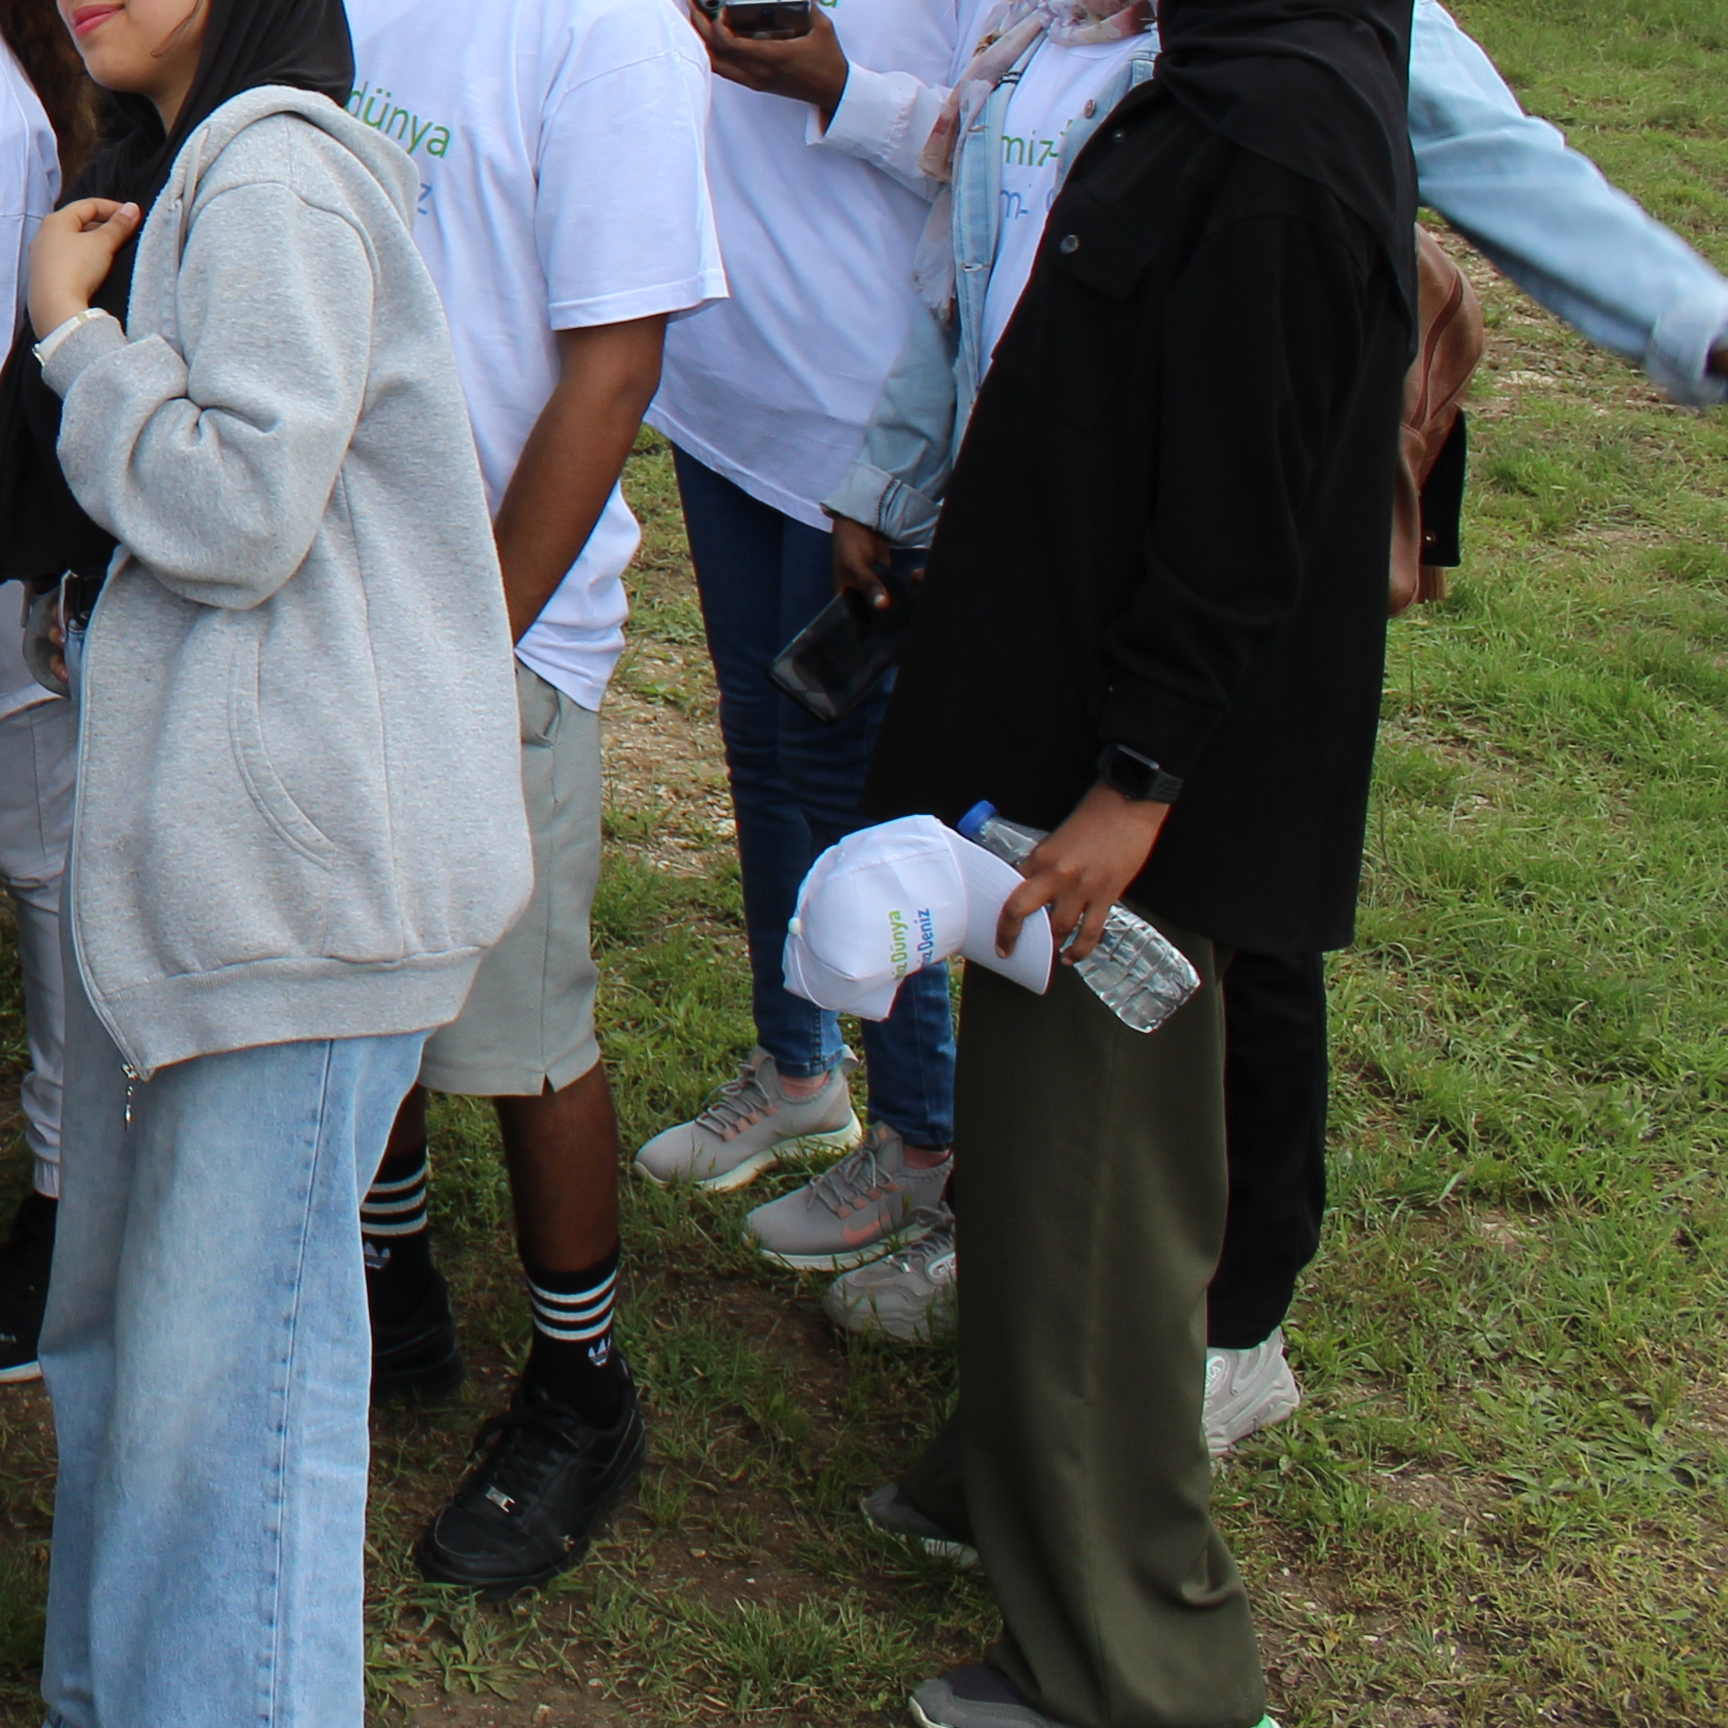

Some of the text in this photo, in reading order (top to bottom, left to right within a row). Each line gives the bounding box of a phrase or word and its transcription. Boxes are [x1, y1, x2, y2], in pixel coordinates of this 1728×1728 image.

[345, 81, 451, 158] dünya
[888, 909, 909, 963] Dünya
[913, 907, 934, 953] Deniz
